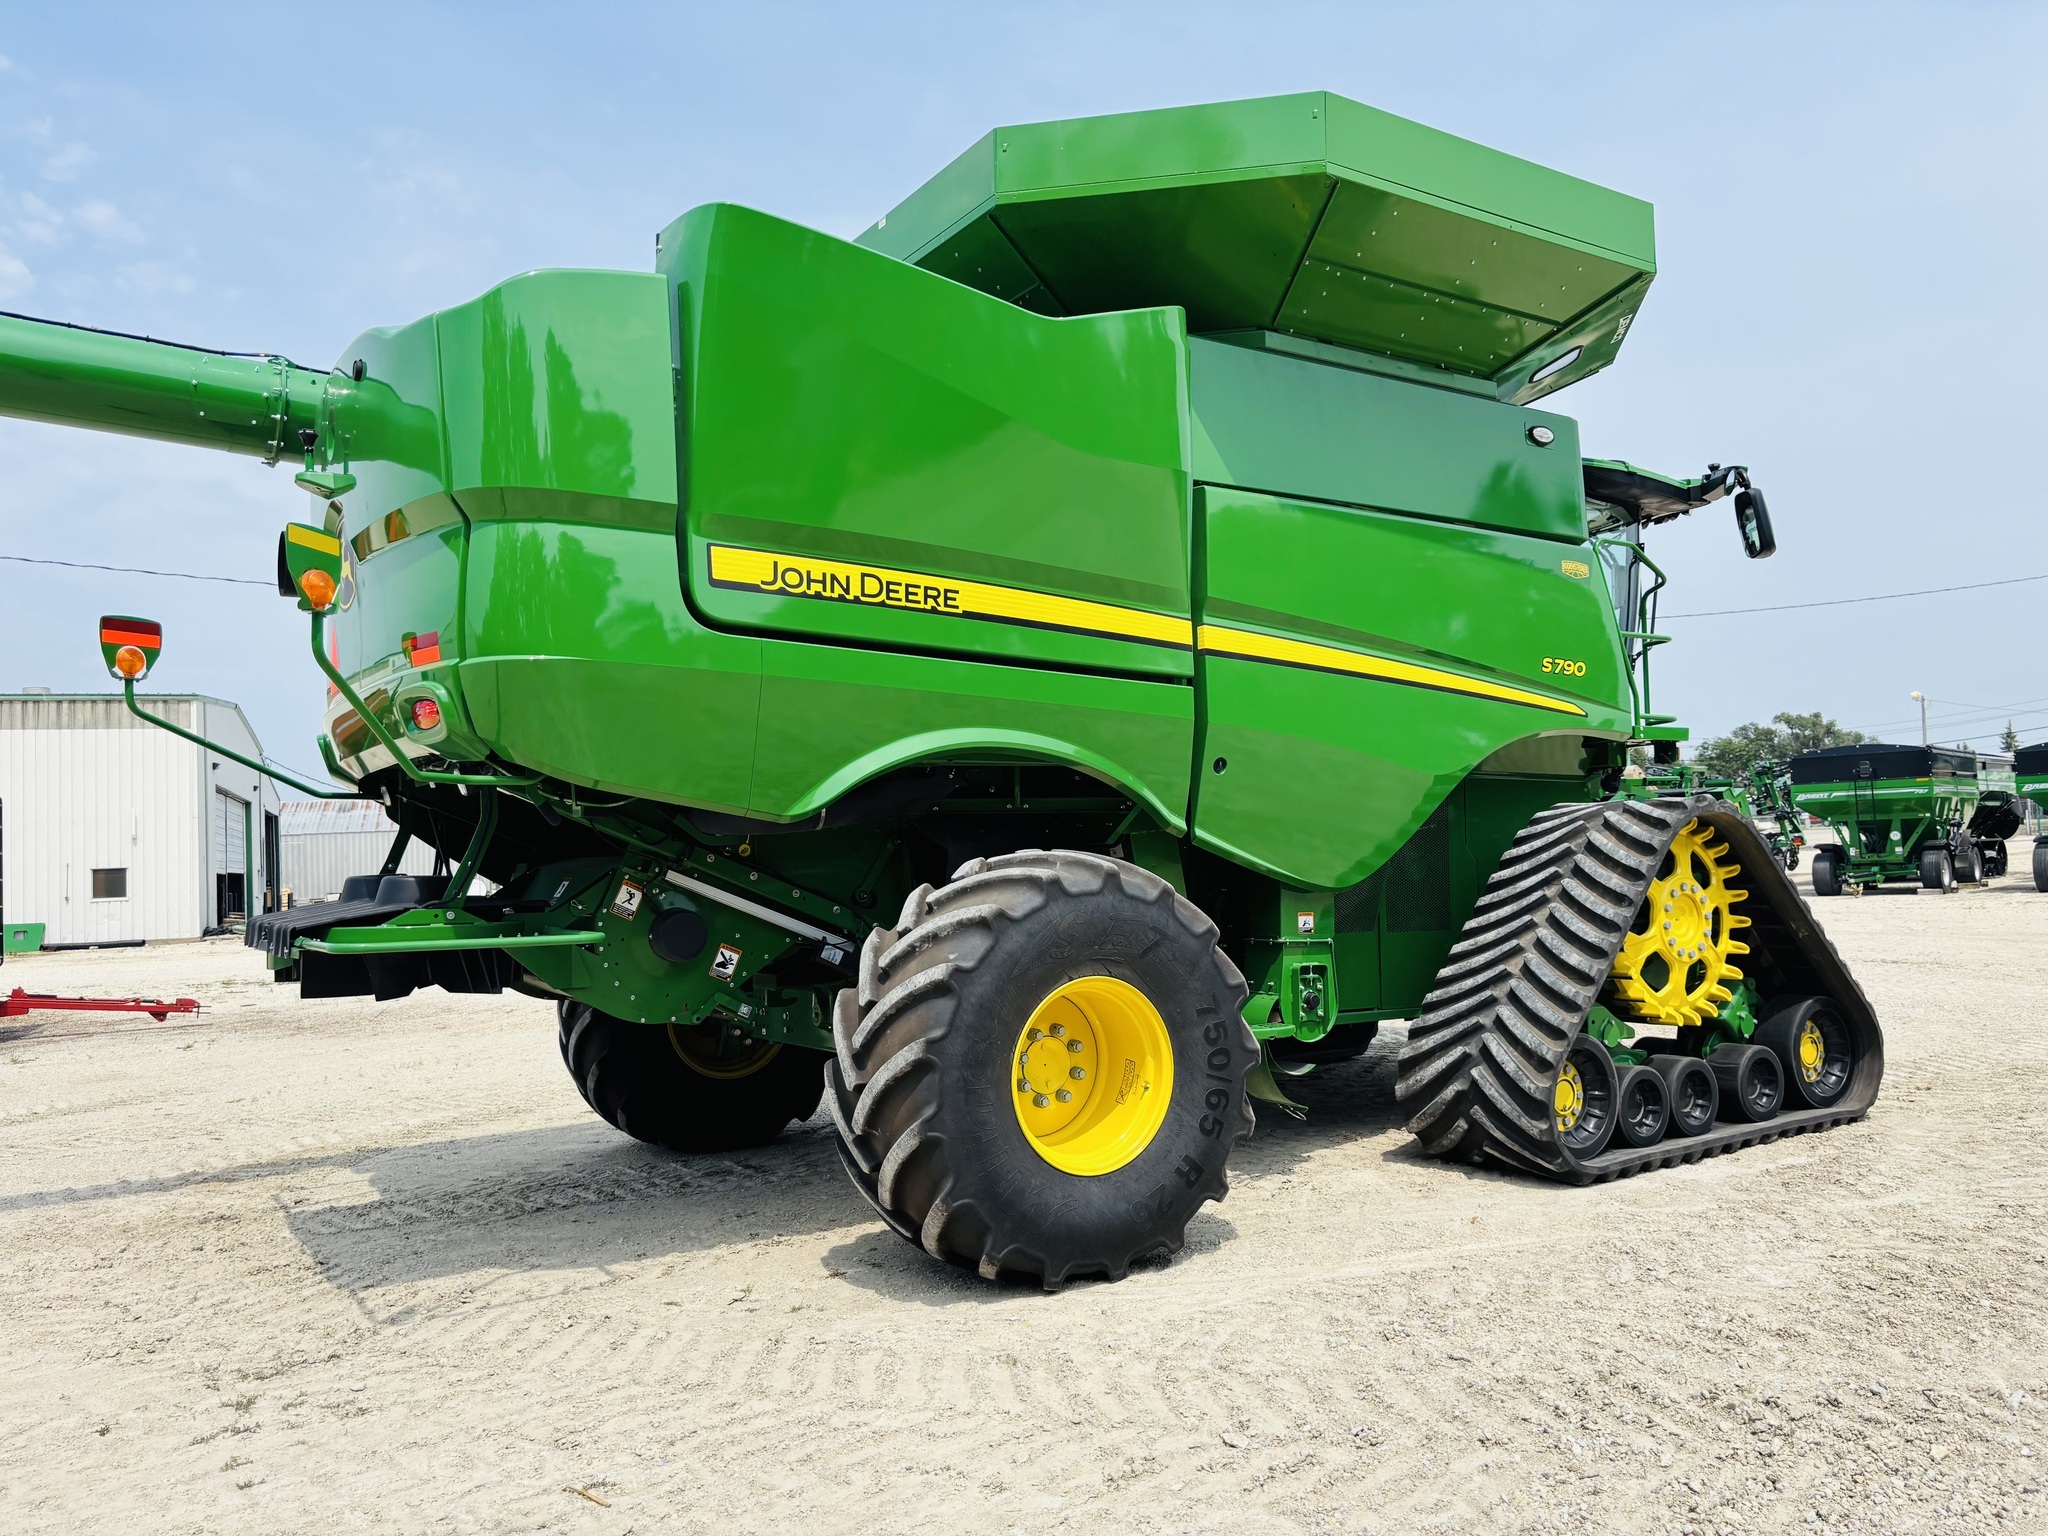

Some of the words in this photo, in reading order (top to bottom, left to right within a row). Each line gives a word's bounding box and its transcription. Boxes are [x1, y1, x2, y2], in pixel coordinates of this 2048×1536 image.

[760, 560, 851, 597] JOHN
[860, 572, 960, 611] DEERE
[1541, 657, 1587, 678] S790
